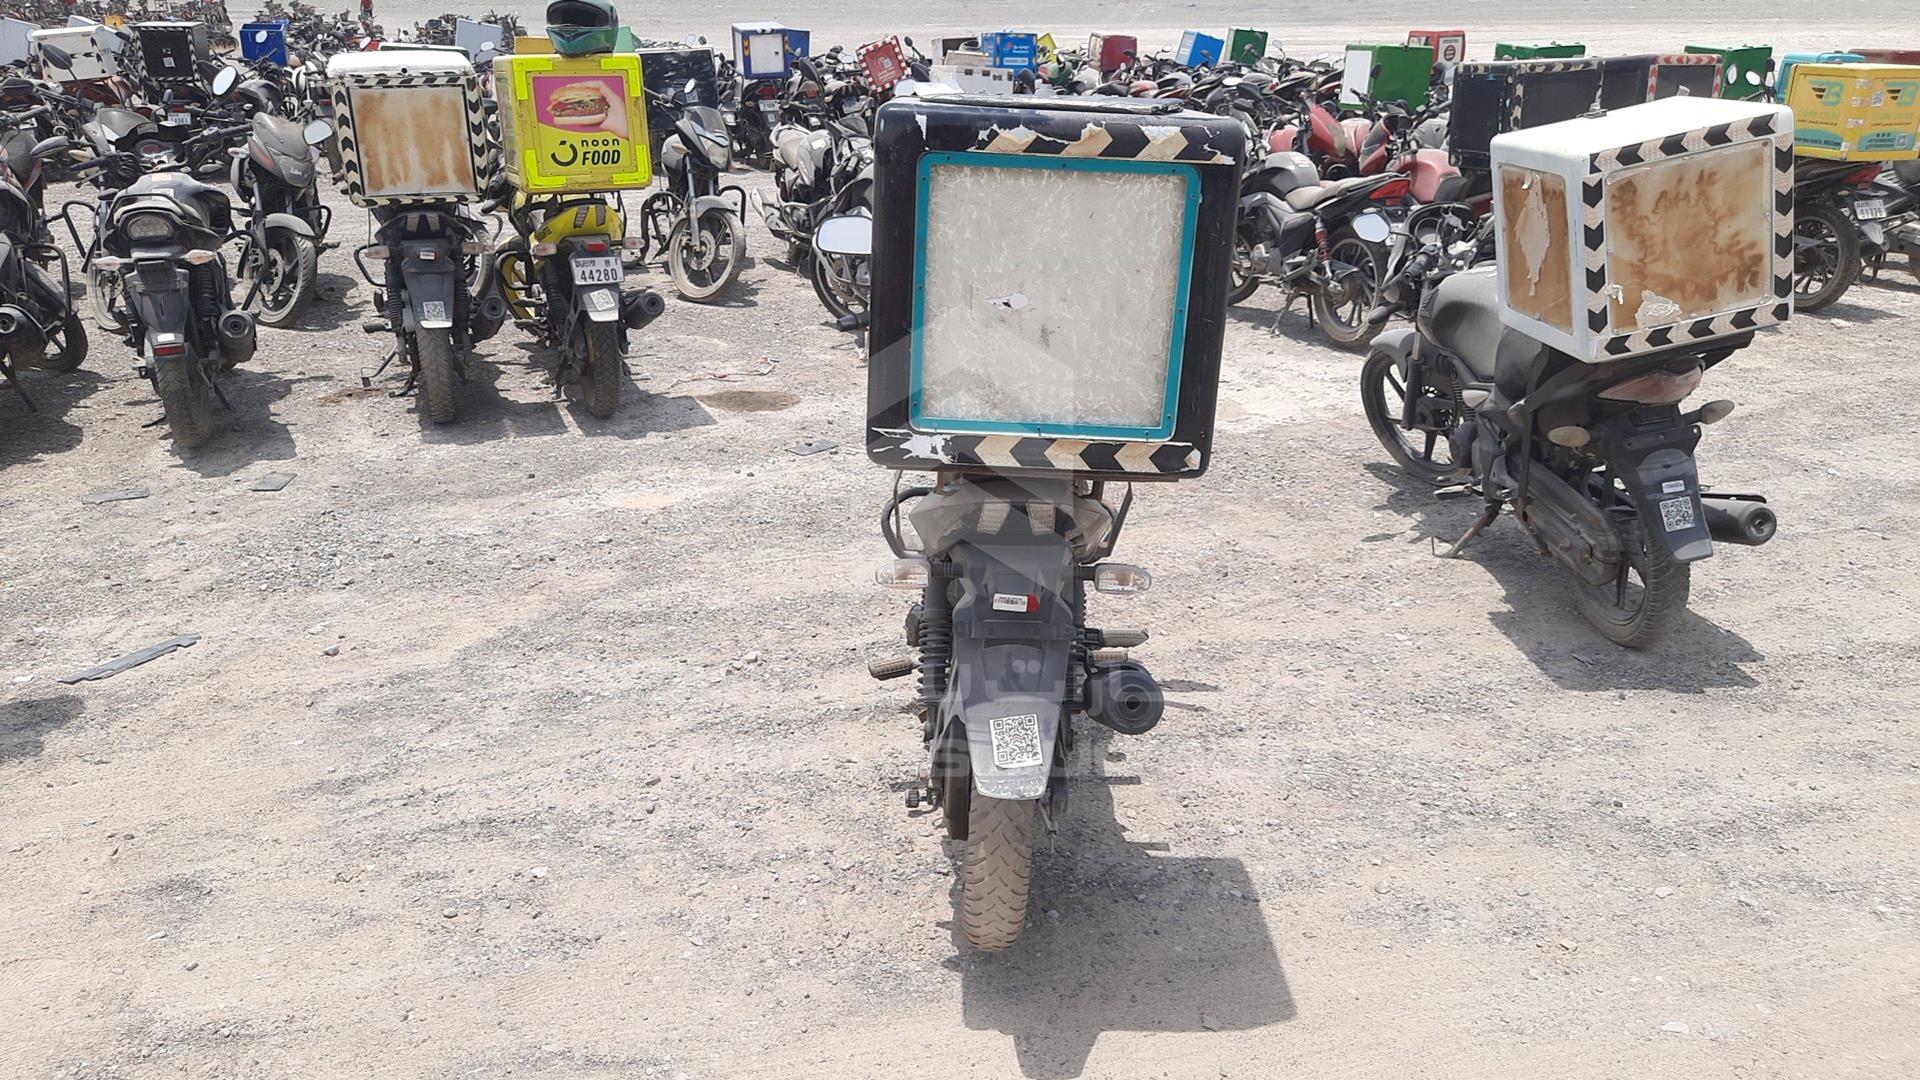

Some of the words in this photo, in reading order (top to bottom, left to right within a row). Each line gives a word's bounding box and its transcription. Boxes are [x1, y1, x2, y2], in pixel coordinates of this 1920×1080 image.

[581, 138, 620, 147] noon
[582, 149, 621, 166] FOOD
[580, 268, 618, 282] 44280
